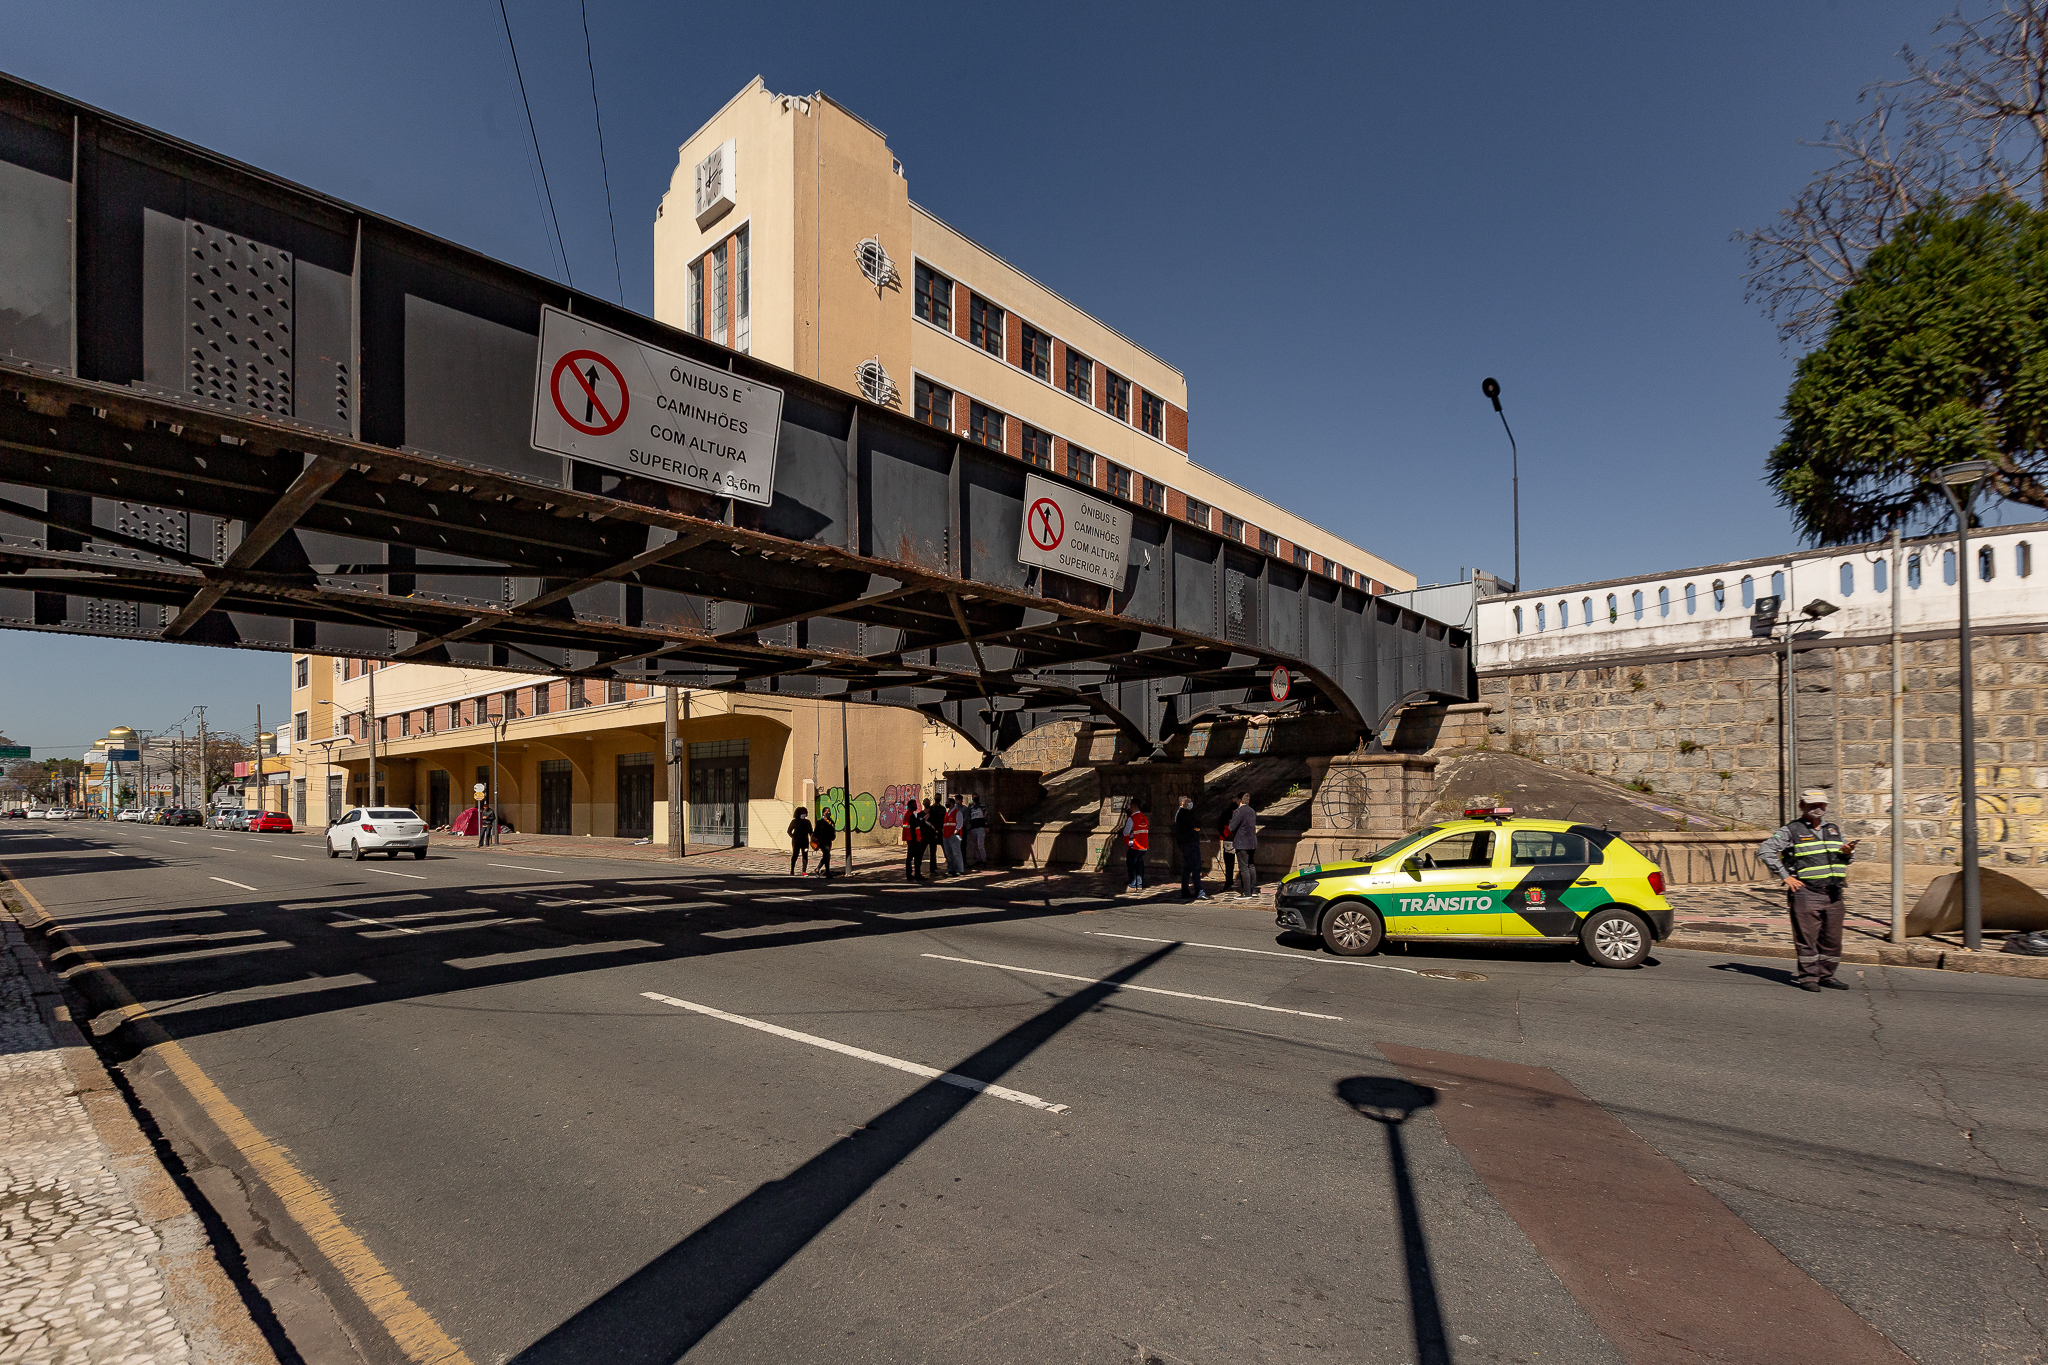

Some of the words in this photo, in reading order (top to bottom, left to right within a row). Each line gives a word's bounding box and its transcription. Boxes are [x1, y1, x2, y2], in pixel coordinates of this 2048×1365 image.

[670, 366, 728, 399] ÔNIBUS
[732, 389, 742, 403] E
[656, 395, 748, 434] CAMINHÕES
[650, 424, 686, 447] COM
[689, 436, 747, 464] ALTURA
[629, 449, 709, 484] SUPERIOR
[712, 471, 722, 485] A
[726, 475, 761, 495] 3,6m
[1081, 503, 1110, 524] ÔNIBUS
[1112, 516, 1117, 527] E
[1074, 521, 1120, 545] CAMINHÕES
[1070, 539, 1089, 552] COM
[1091, 544, 1120, 563] ALTURA
[1059, 554, 1100, 576] SUPERIOR
[1102, 568, 1108, 578] A
[1399, 893, 1493, 912] TRÂNSITO
